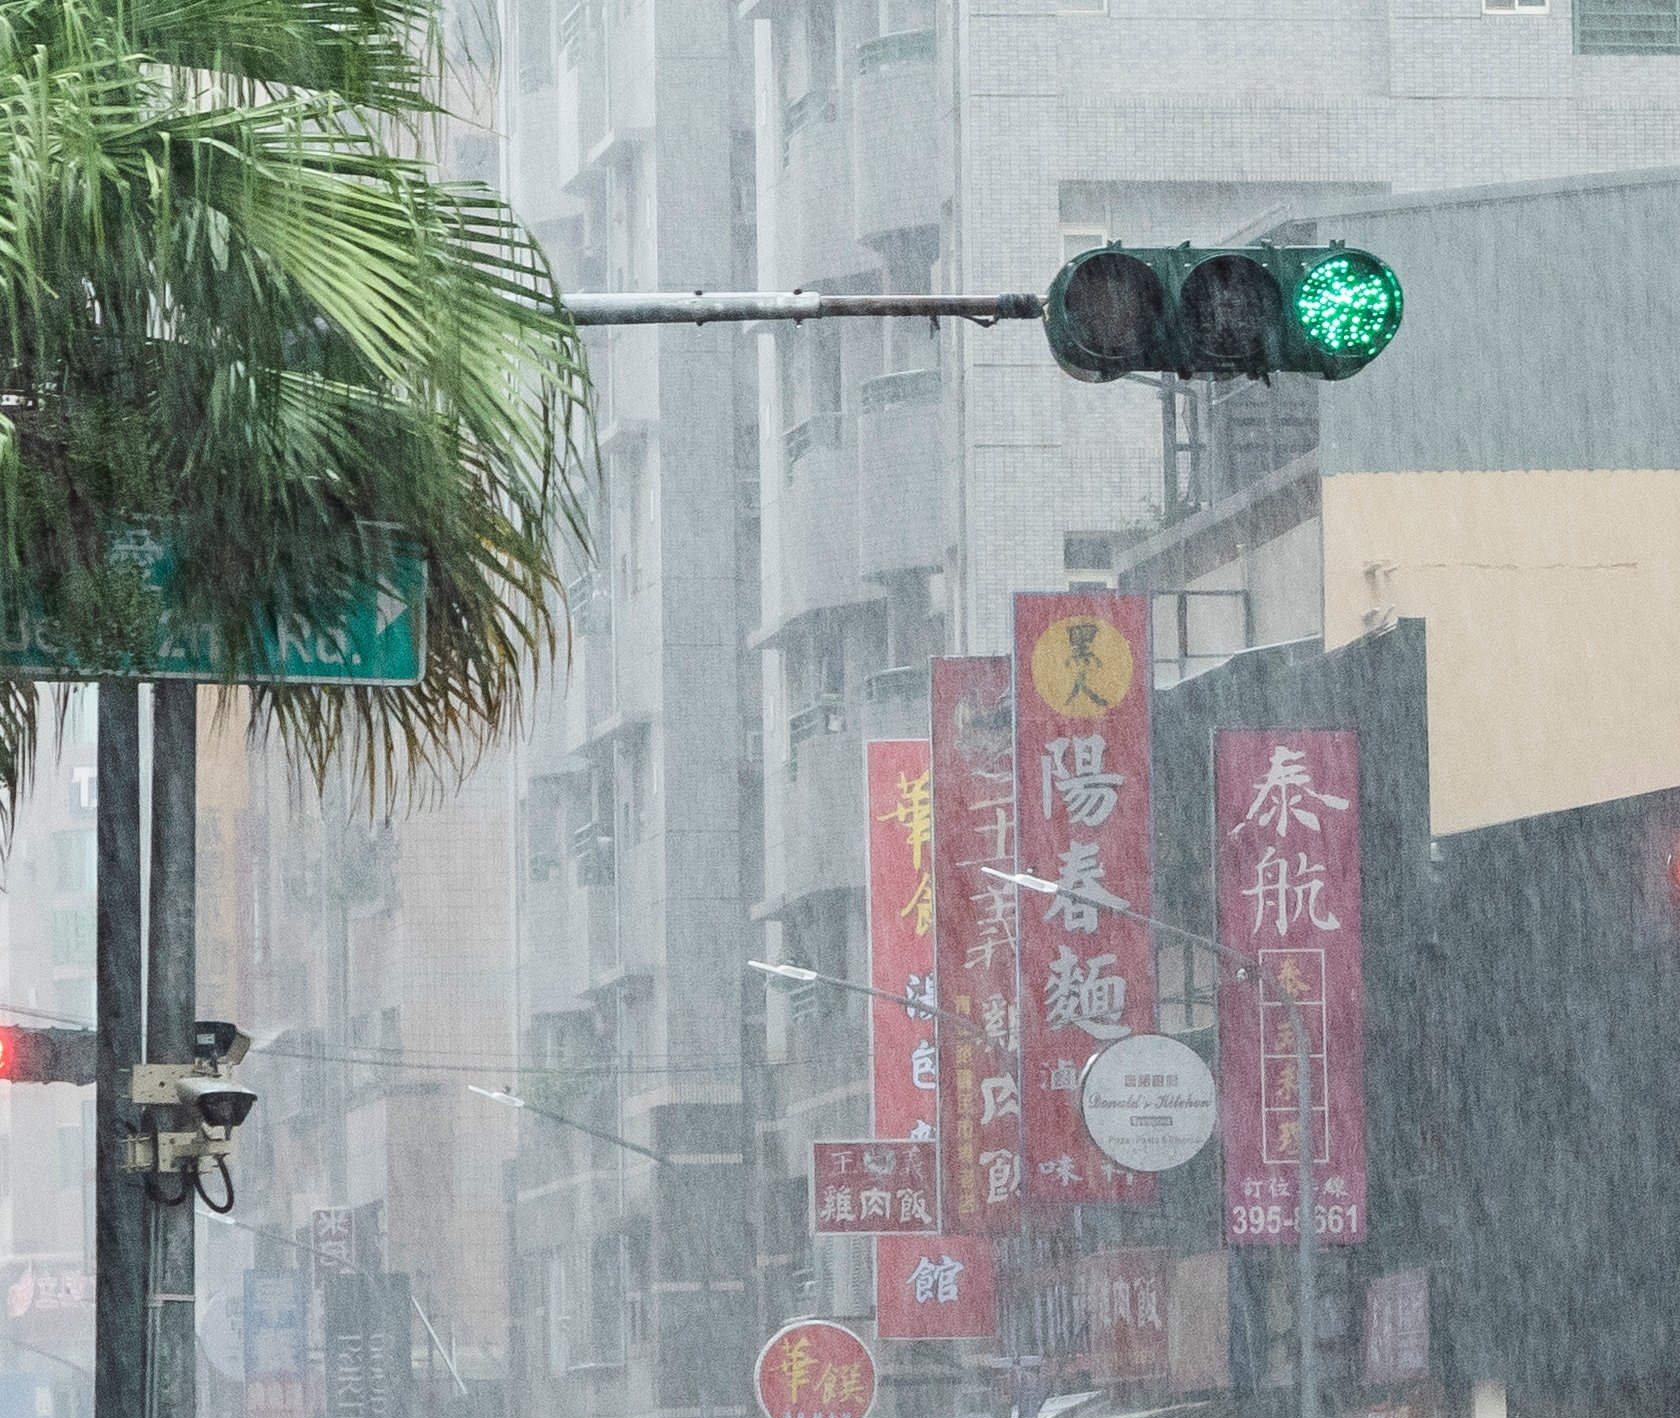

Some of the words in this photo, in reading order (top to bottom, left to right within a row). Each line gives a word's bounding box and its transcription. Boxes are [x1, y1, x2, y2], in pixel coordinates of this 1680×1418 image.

[1064, 623, 1109, 709] 黑人
[1227, 745, 1351, 937] 泰航
[1040, 733, 1133, 1041] 陽春麵
[818, 1185, 933, 1226] 雞肉飯
[1240, 1174, 1349, 1200] 訂位線
